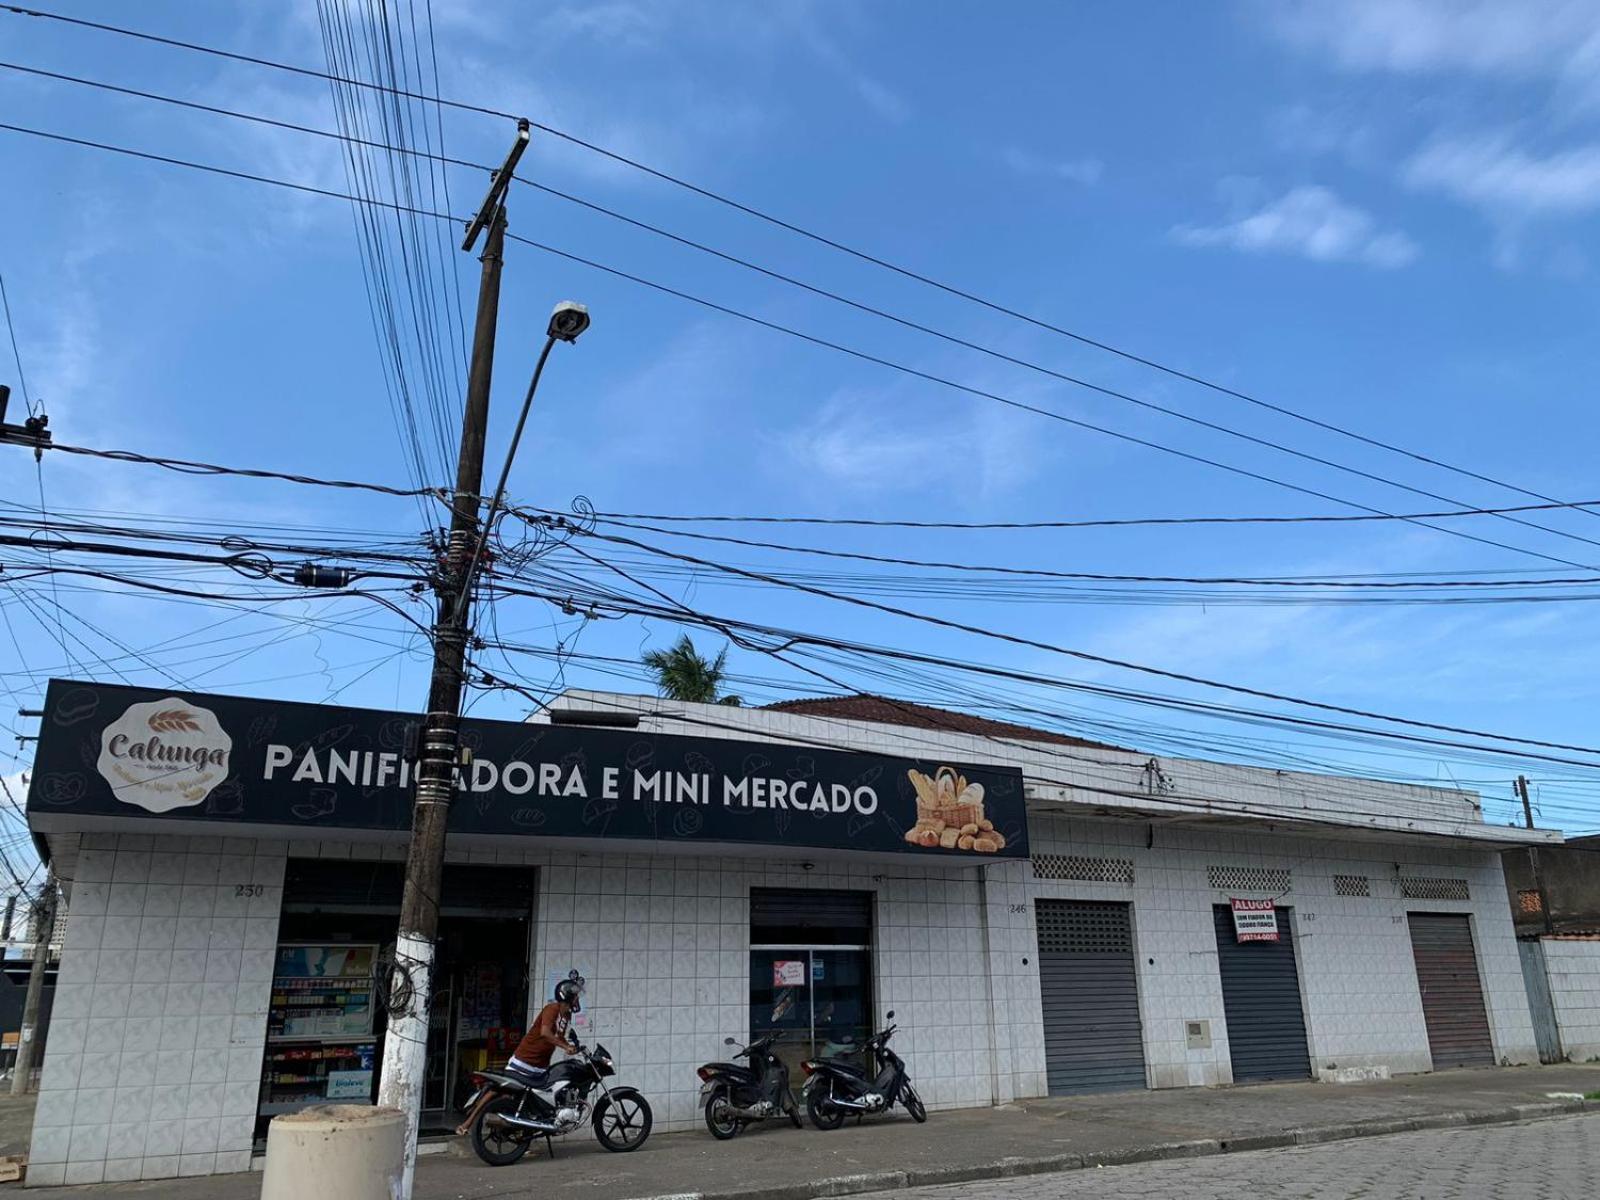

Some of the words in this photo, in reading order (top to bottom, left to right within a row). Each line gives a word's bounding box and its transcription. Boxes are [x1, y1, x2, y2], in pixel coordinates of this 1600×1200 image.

[109, 733, 225, 773] Calunga
[263, 743, 588, 797] PANIFIADORA
[602, 766, 619, 799] E
[633, 768, 709, 804] MINI
[723, 775, 878, 815] MERCADO
[1009, 903, 1026, 913] 246
[1235, 900, 1272, 910] ALUGO
